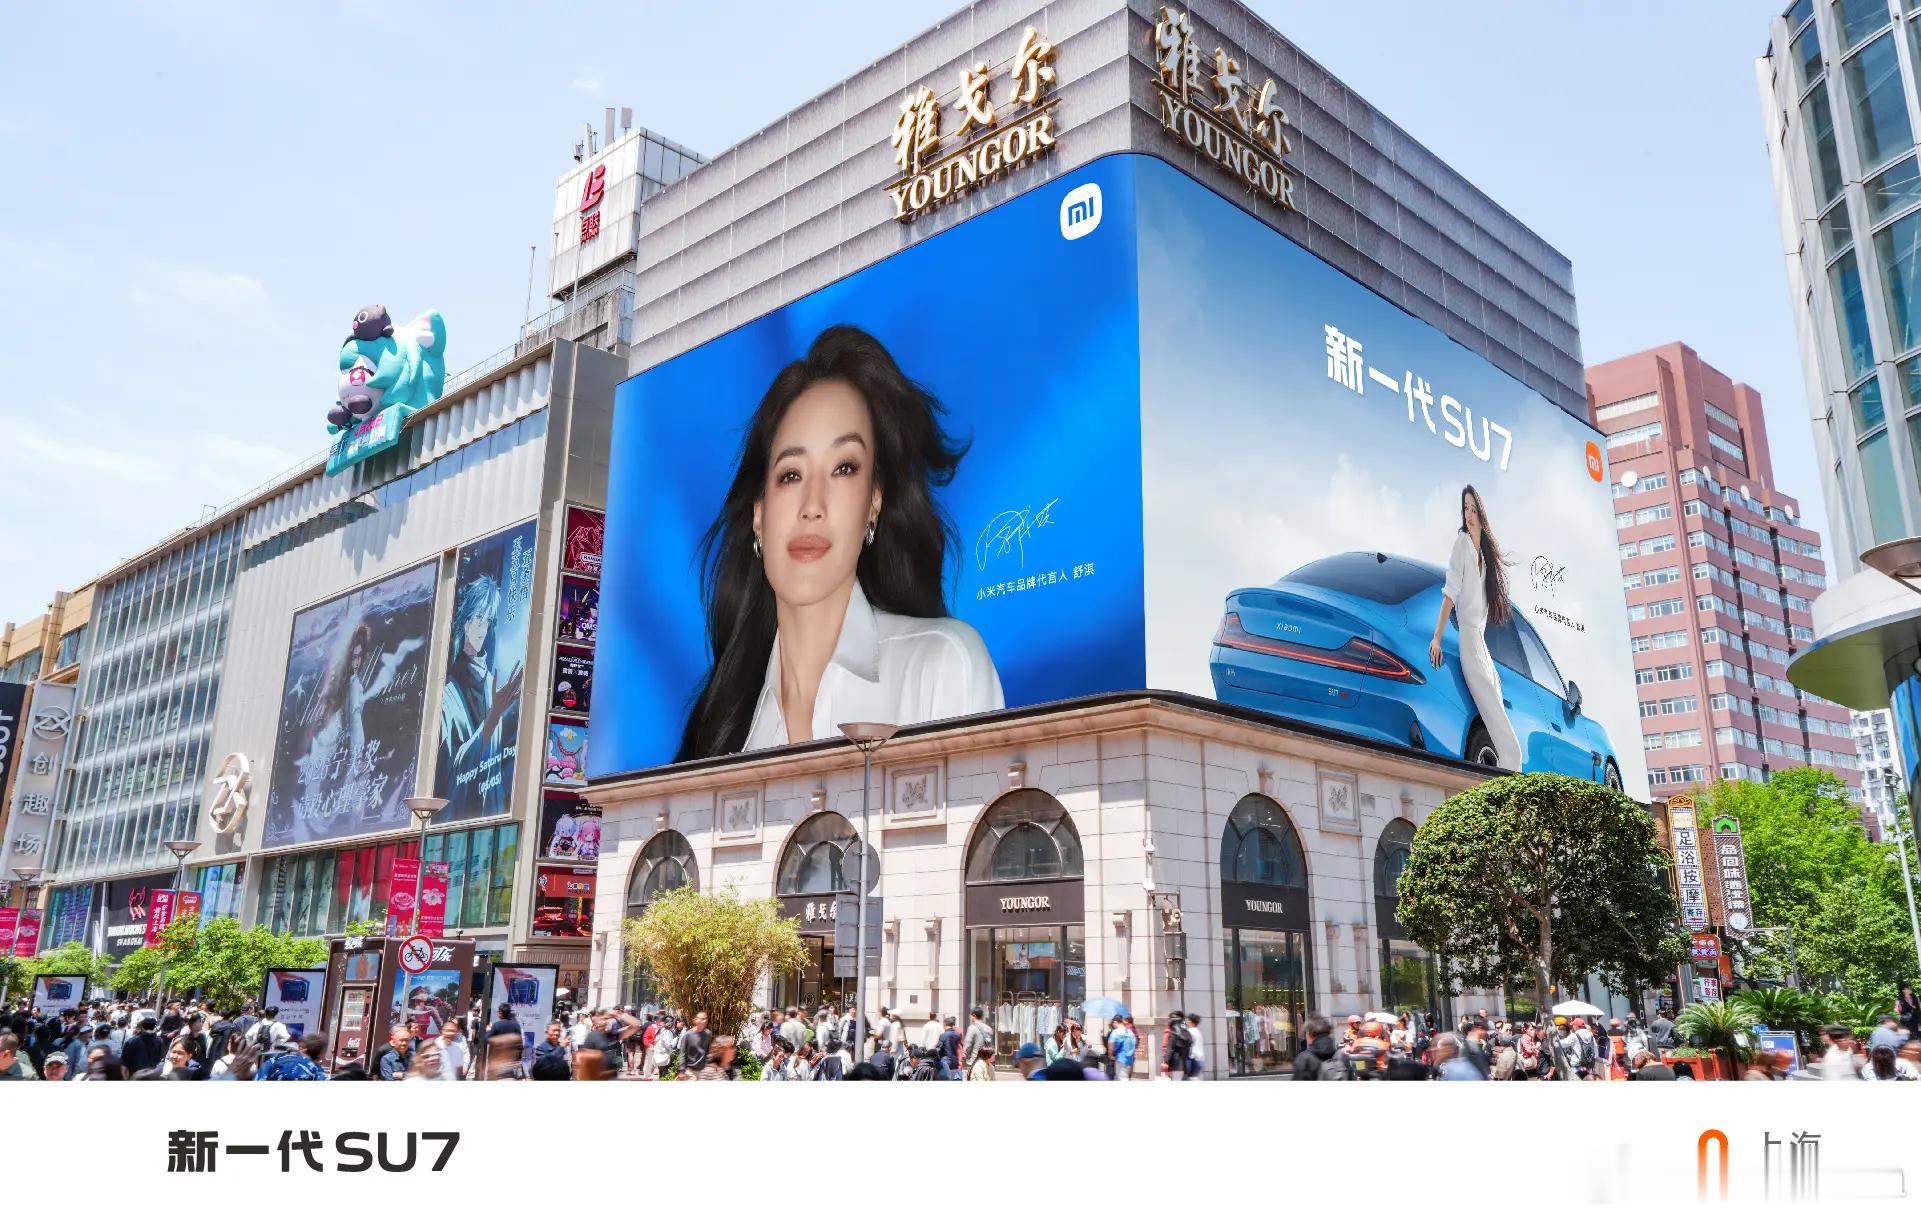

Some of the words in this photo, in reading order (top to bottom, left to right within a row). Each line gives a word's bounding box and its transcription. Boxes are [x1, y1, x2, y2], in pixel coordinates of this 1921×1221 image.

[890, 25, 1058, 175] 雅戈尔
[1155, 5, 1292, 155] 雅戈尔
[889, 113, 1056, 219] YOUNGOR
[1159, 90, 1298, 211] YOUNGOR
[1325, 323, 1437, 434] 新一代
[1441, 394, 1512, 472] SU7
[976, 568, 1068, 601] 小米汽车品牌代言人
[15, 751, 60, 857] 创趣场
[456, 766, 478, 786] Happy
[503, 745, 517, 759] Day
[999, 896, 1051, 911] YOUNGOR
[1245, 899, 1284, 914] YOUNGOR
[1679, 831, 1702, 903] 足浴按摩
